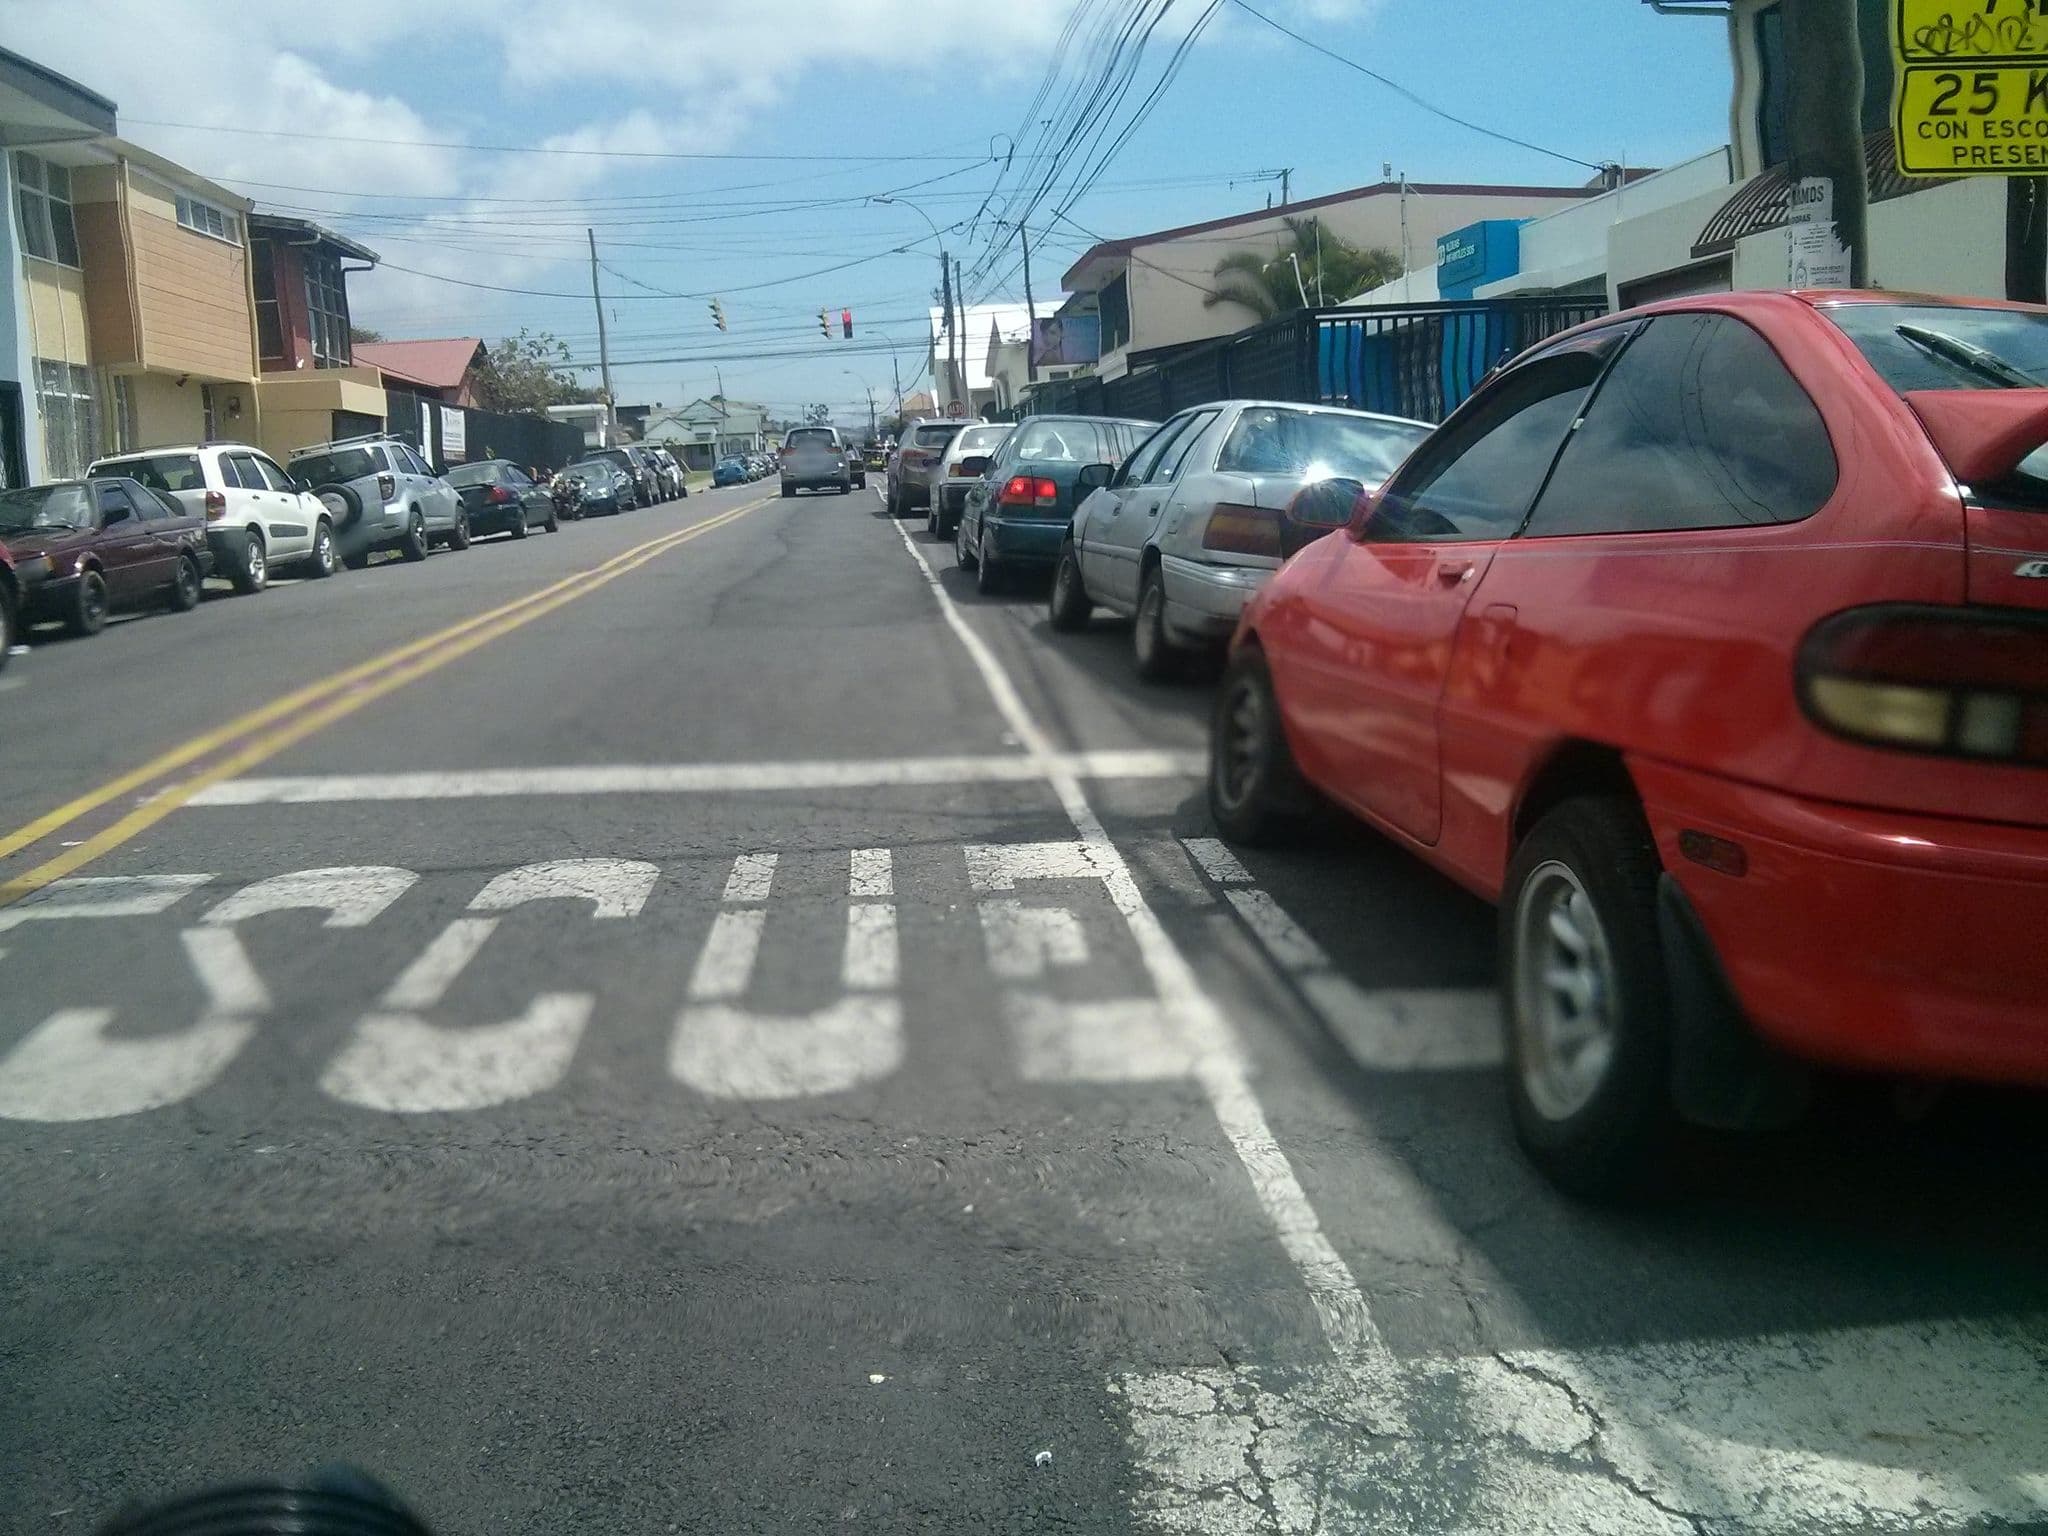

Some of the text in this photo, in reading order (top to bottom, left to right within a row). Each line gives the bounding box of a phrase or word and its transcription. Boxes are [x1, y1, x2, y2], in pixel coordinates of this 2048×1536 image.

[1929, 73, 1998, 116] 25
[1918, 119, 2048, 139] CON ESCO
[948, 403, 964, 415] ALTO
